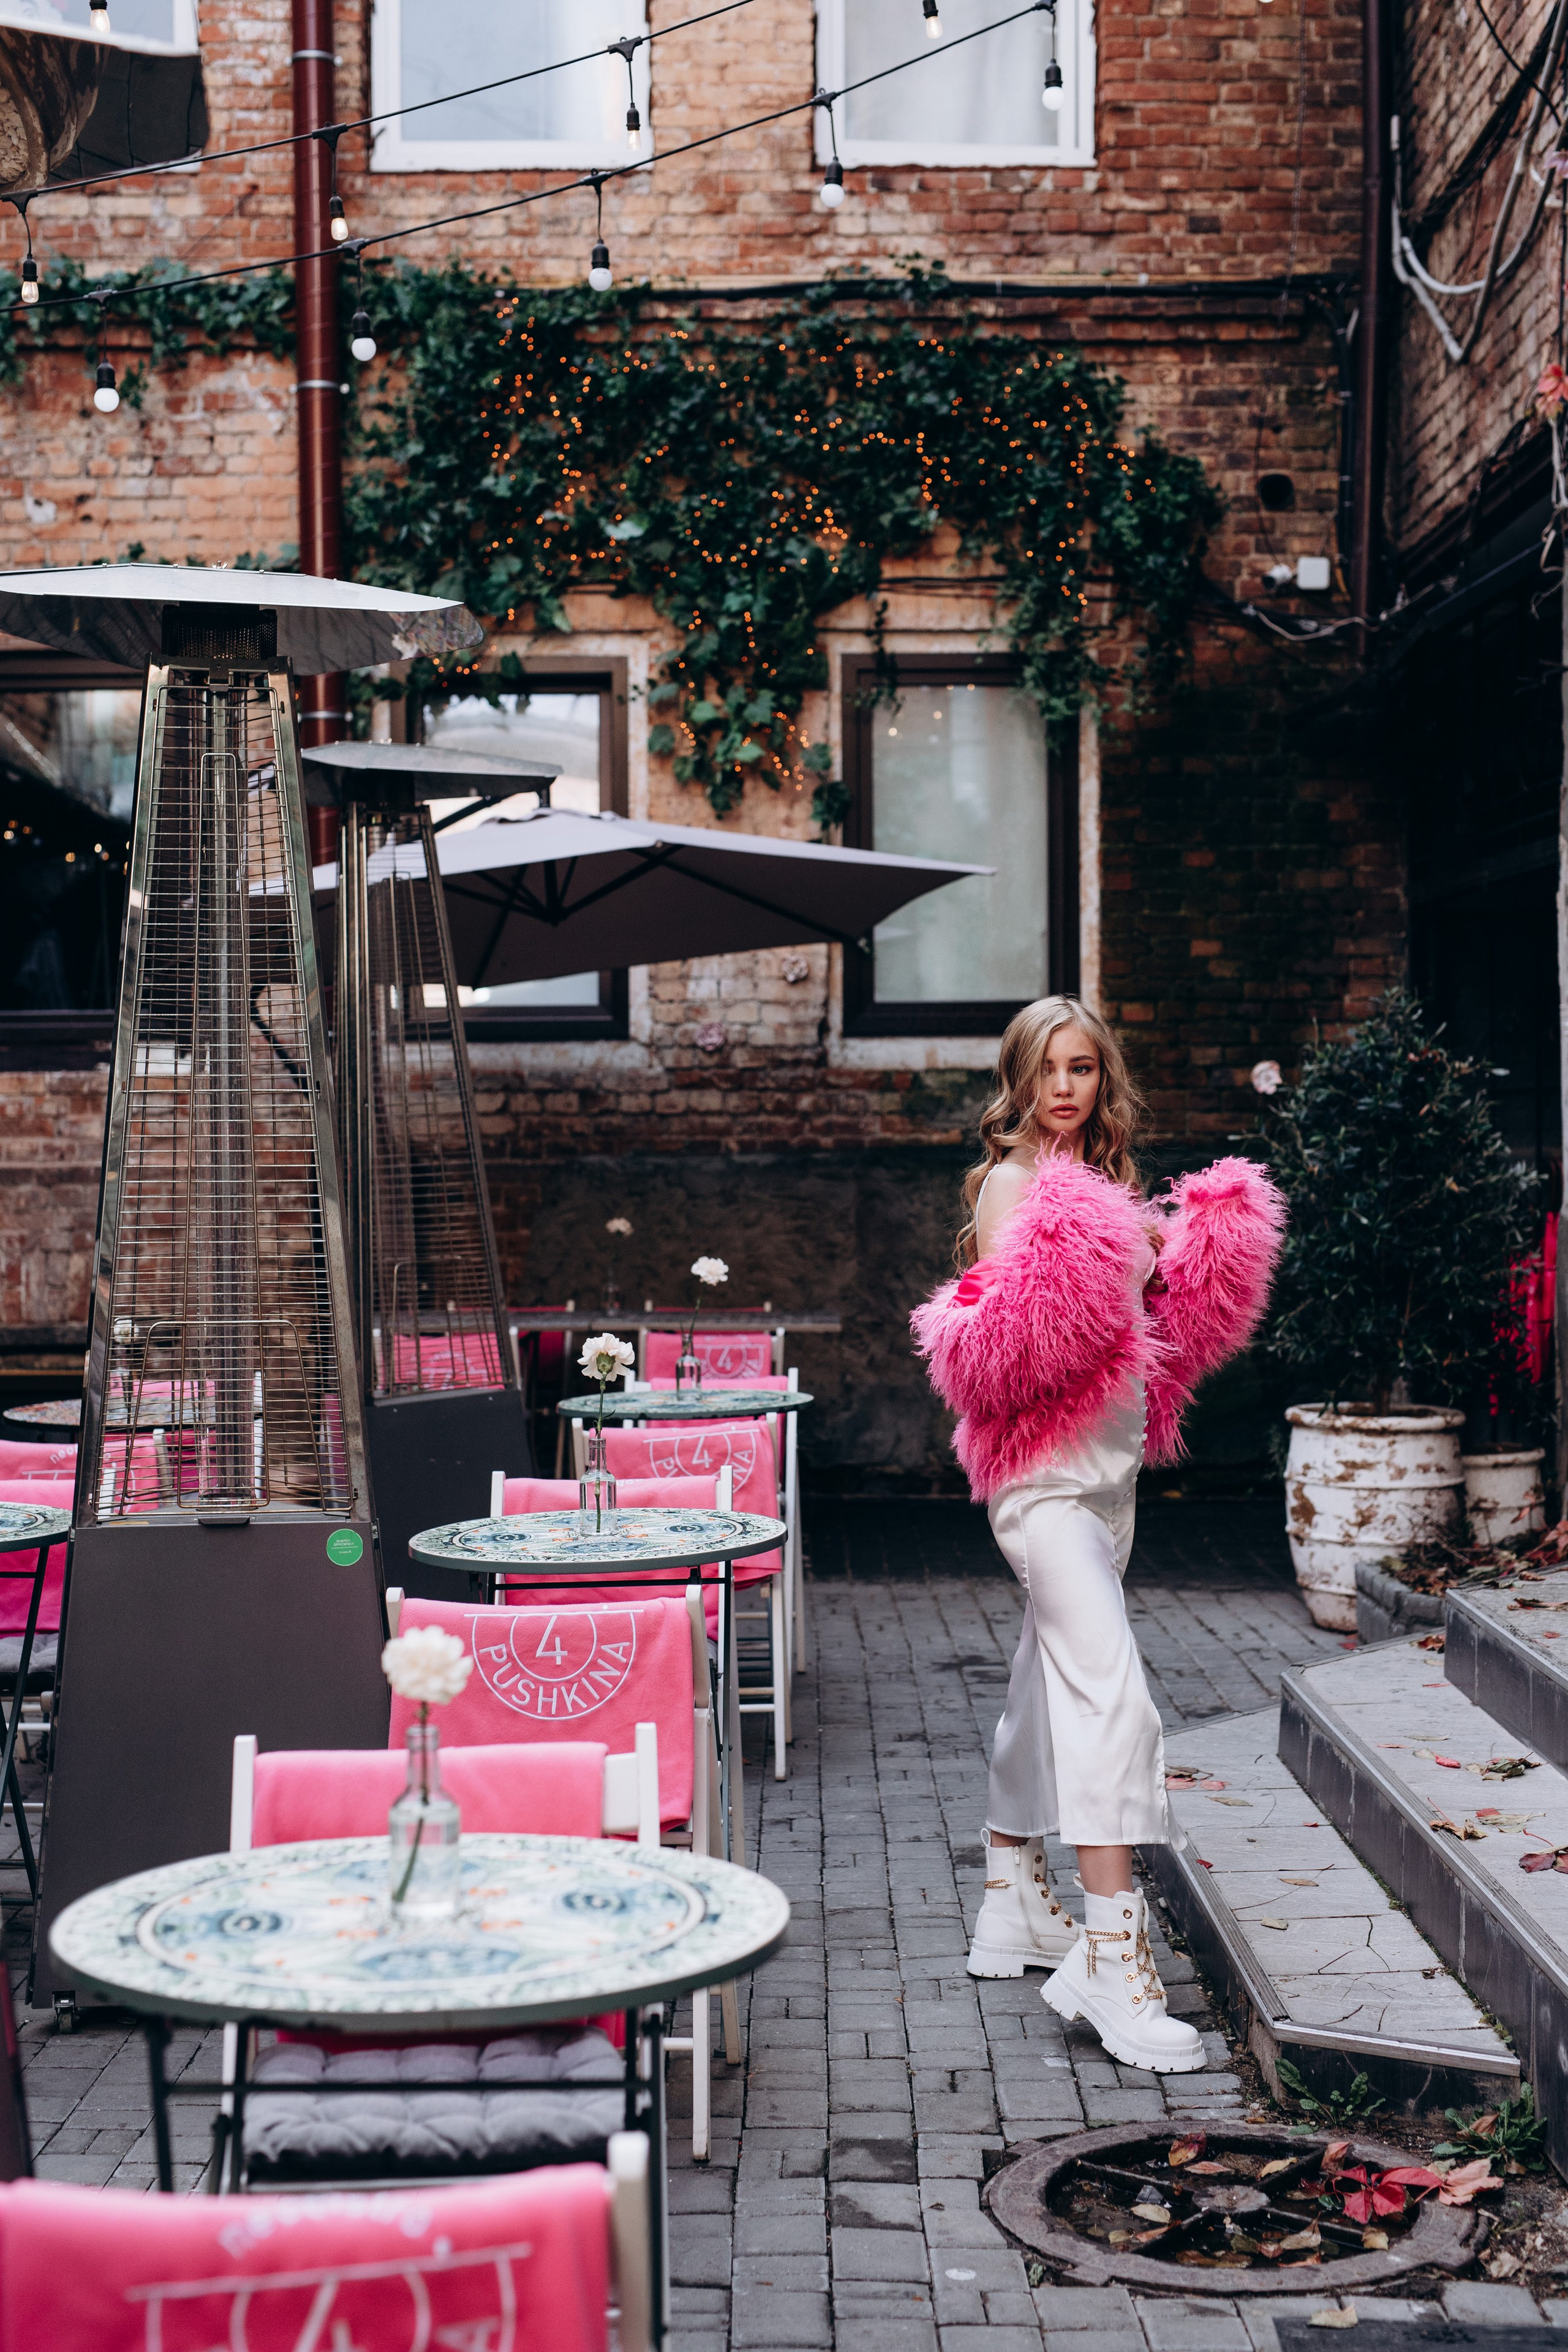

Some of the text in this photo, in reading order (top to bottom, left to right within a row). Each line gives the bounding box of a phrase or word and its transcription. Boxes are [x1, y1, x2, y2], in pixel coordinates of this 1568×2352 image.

[692, 1435, 714, 1468] 4
[535, 1614, 568, 1665] 4
[479, 1642, 630, 1714] PUSHKINA
